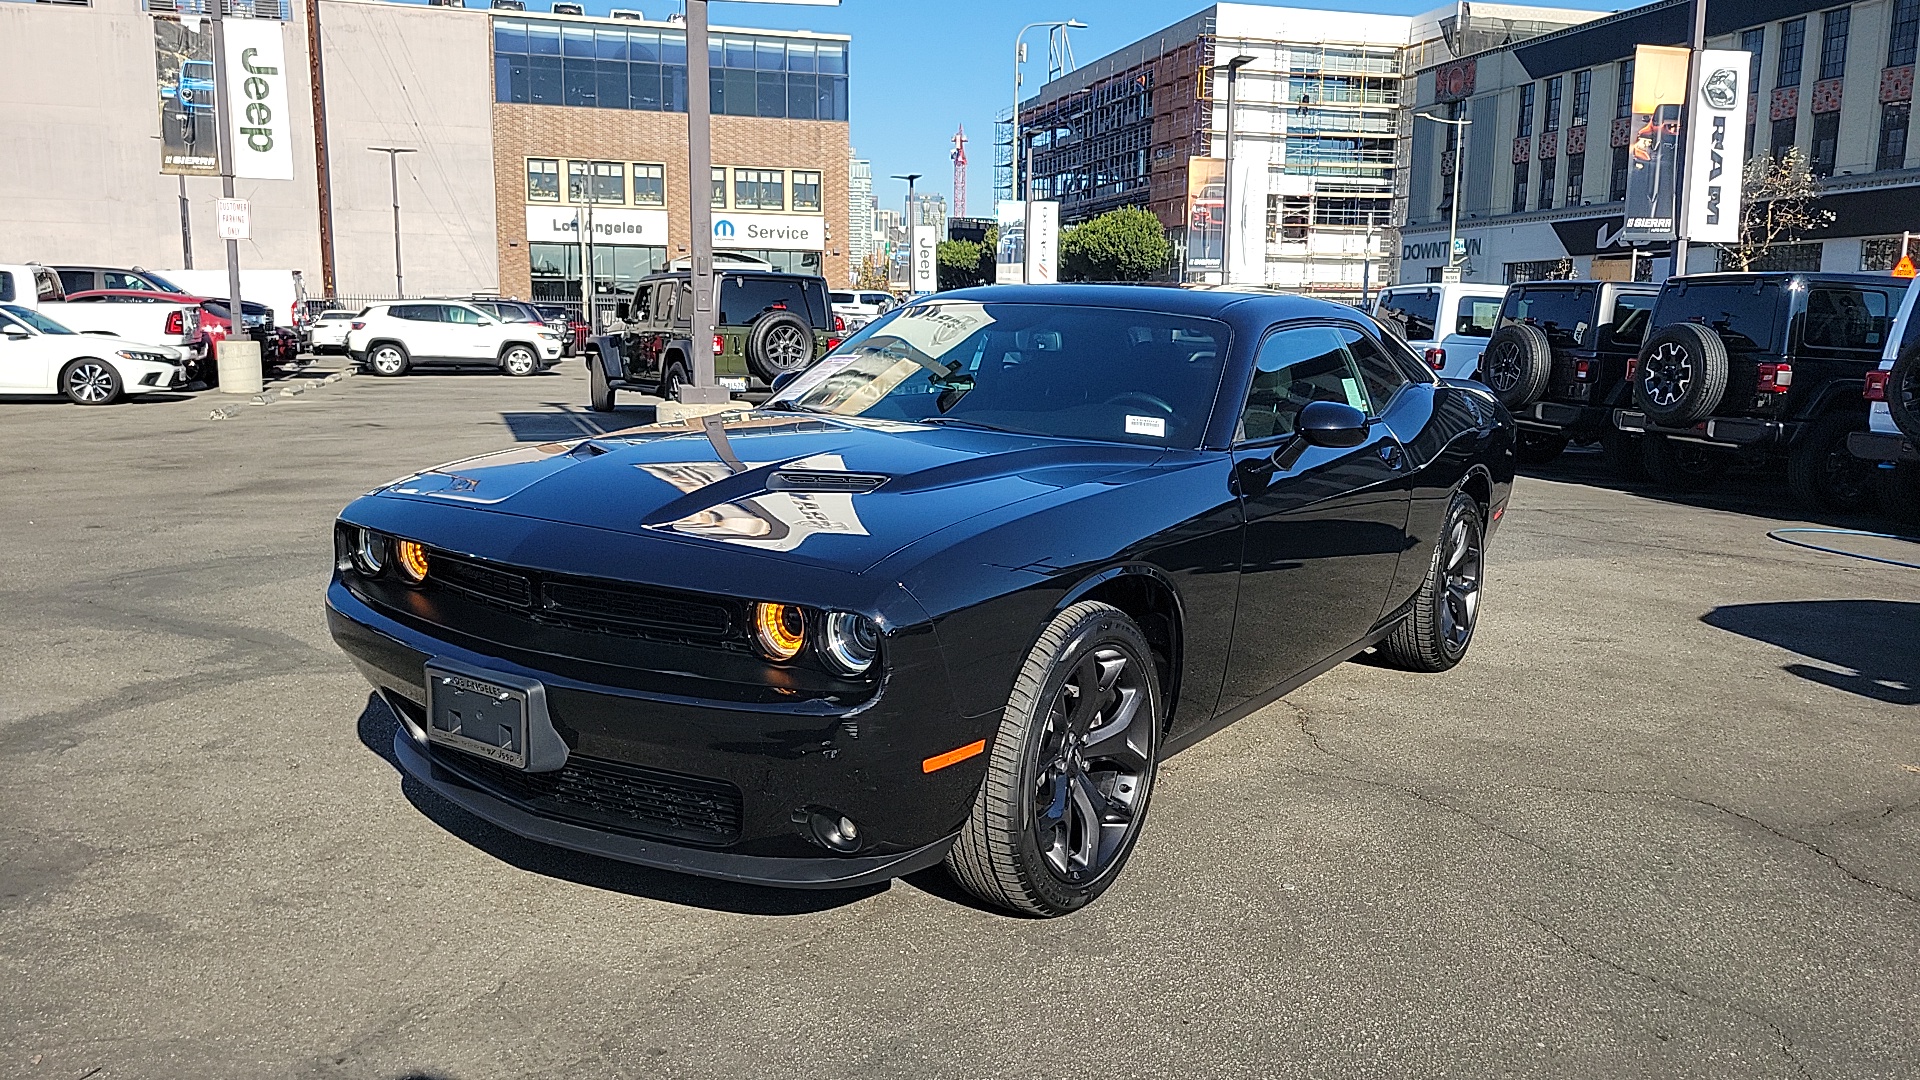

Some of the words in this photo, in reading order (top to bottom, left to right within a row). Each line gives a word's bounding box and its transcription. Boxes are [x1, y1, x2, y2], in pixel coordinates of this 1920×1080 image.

[240, 48, 279, 152] Jeep
[1706, 116, 1726, 225] RAM
[219, 202, 247, 211] CUSTOMER
[222, 214, 245, 223] PARKING
[1634, 218, 1672, 228] SIERRA
[227, 226, 241, 236] ONLY
[747, 224, 809, 240] Service
[918, 237, 933, 280] Jeep
